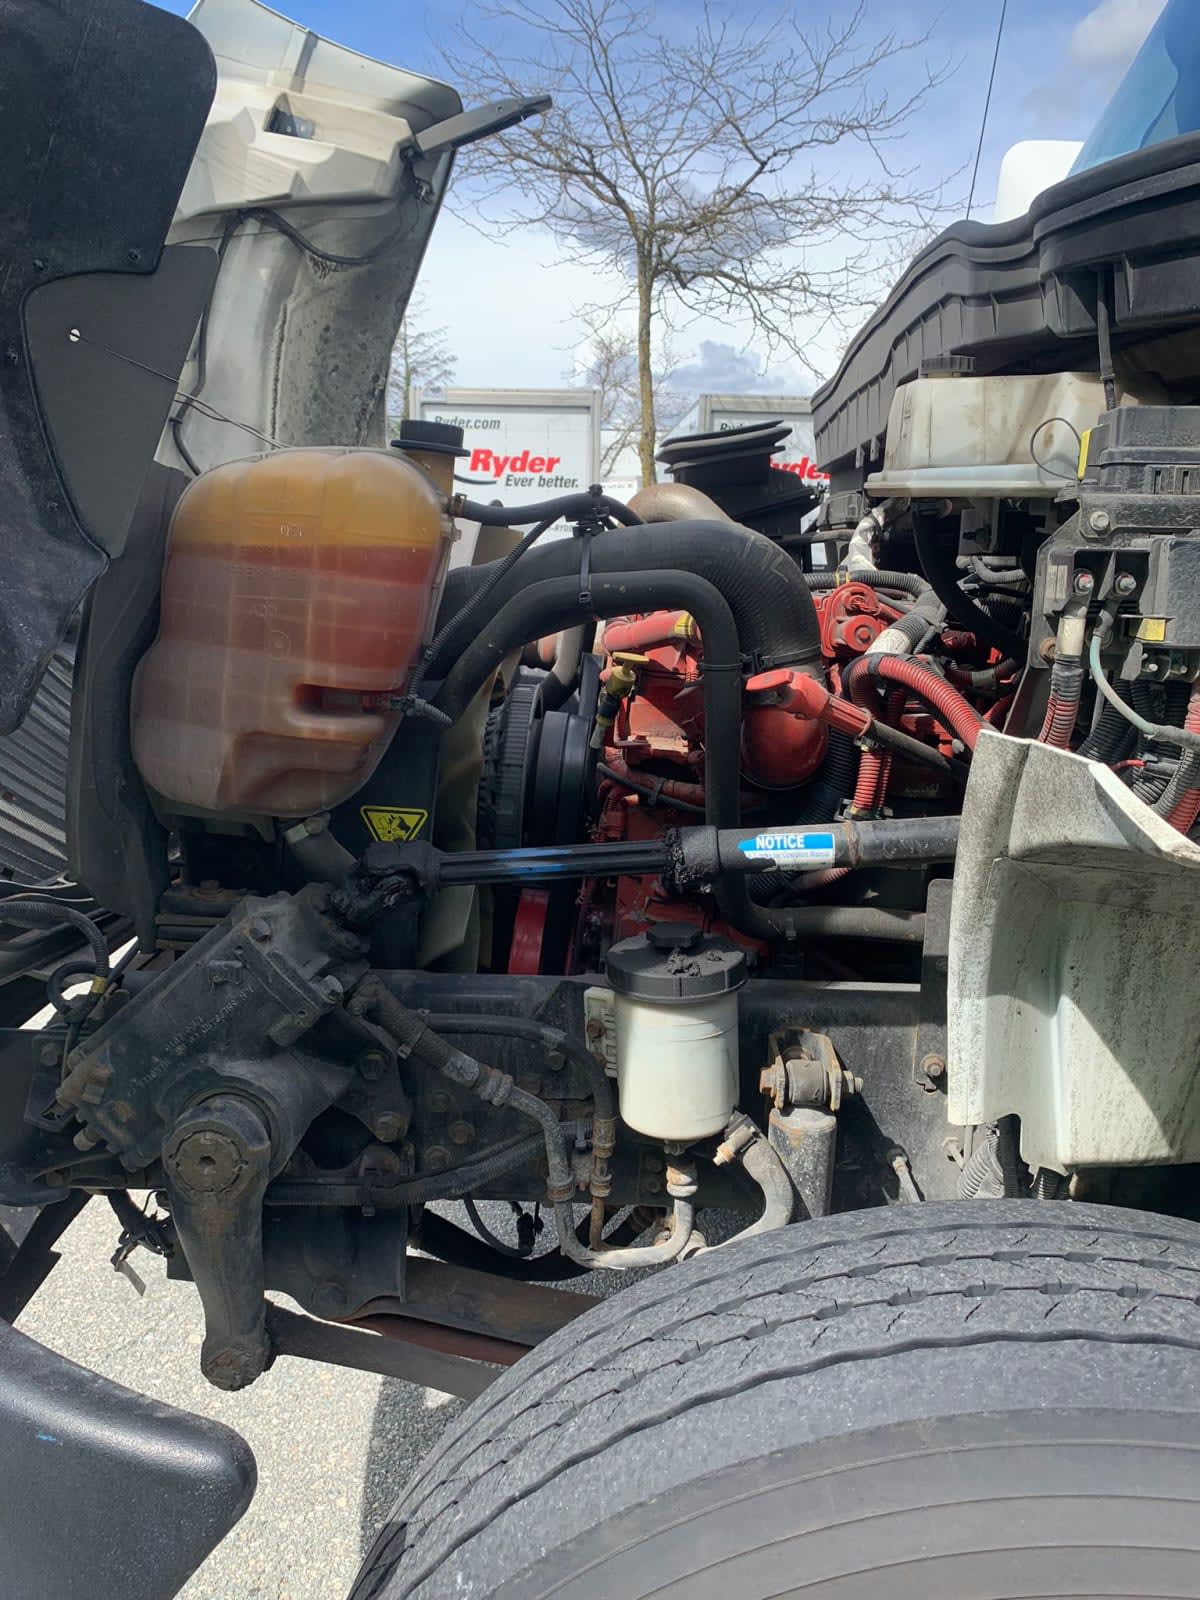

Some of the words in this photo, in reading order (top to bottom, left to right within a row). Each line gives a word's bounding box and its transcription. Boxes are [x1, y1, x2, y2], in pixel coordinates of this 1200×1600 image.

[469, 447, 561, 478] Ryder
[505, 474, 535, 488] Ever
[538, 475, 579, 489] better.
[755, 834, 805, 850] NOTICE
